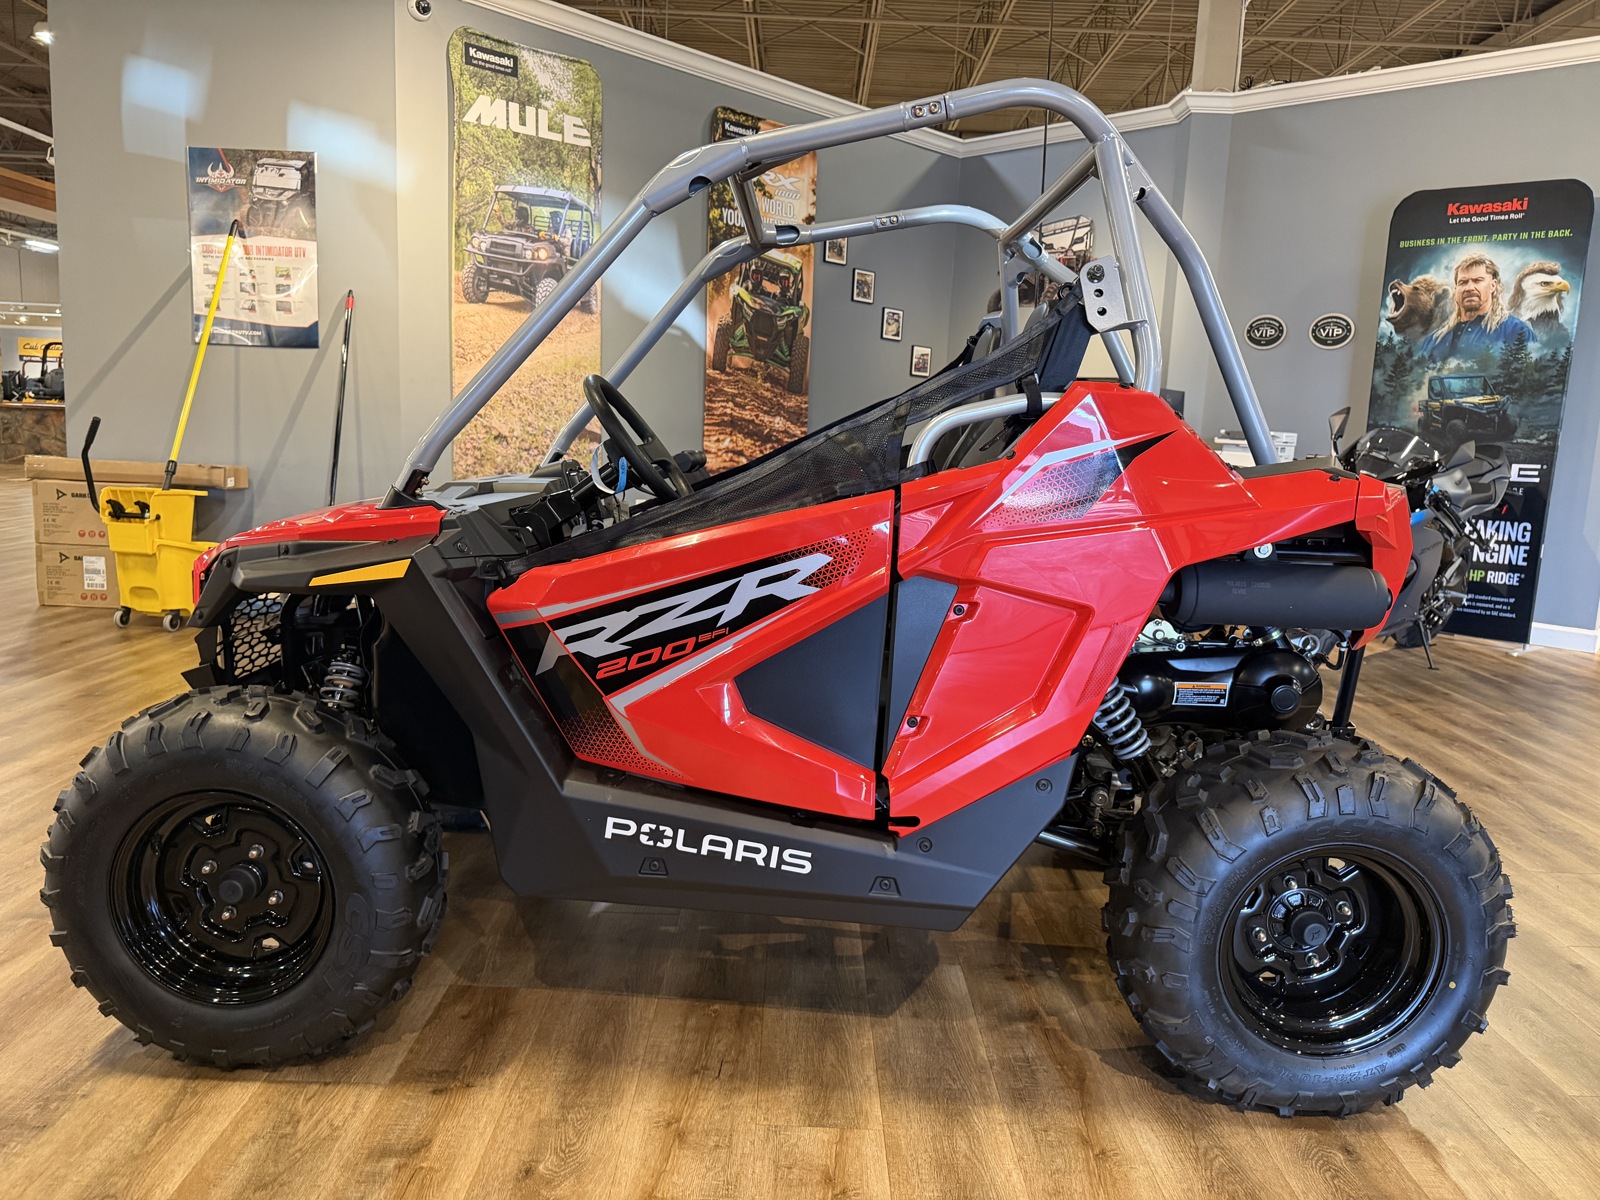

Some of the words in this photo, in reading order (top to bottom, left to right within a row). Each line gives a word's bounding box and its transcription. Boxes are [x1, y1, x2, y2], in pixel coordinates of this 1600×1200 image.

[468, 46, 514, 68] Kawasaki
[462, 94, 592, 147] MULE
[196, 176, 247, 186] INTIMIDATOR
[1447, 197, 1529, 216] Kawasaki
[1489, 213, 1509, 221] Times
[1399, 238, 1435, 248] BUSINESS
[1437, 237, 1446, 245] IN
[1447, 236, 1462, 244] THE
[1463, 234, 1490, 243] FRONT.
[1492, 232, 1518, 241] PARTY
[1520, 231, 1529, 240] IN
[1531, 231, 1546, 239] THE
[1548, 228, 1573, 238] BACK.
[1254, 328, 1276, 338] VIP
[1320, 327, 1343, 337] VIP
[1469, 541, 1530, 567] NGINE
[1469, 569, 1486, 583] HP
[535, 553, 834, 676] RZR
[596, 636, 697, 680] 200
[698, 627, 729, 643] EFI
[604, 816, 813, 874] POLARIS
